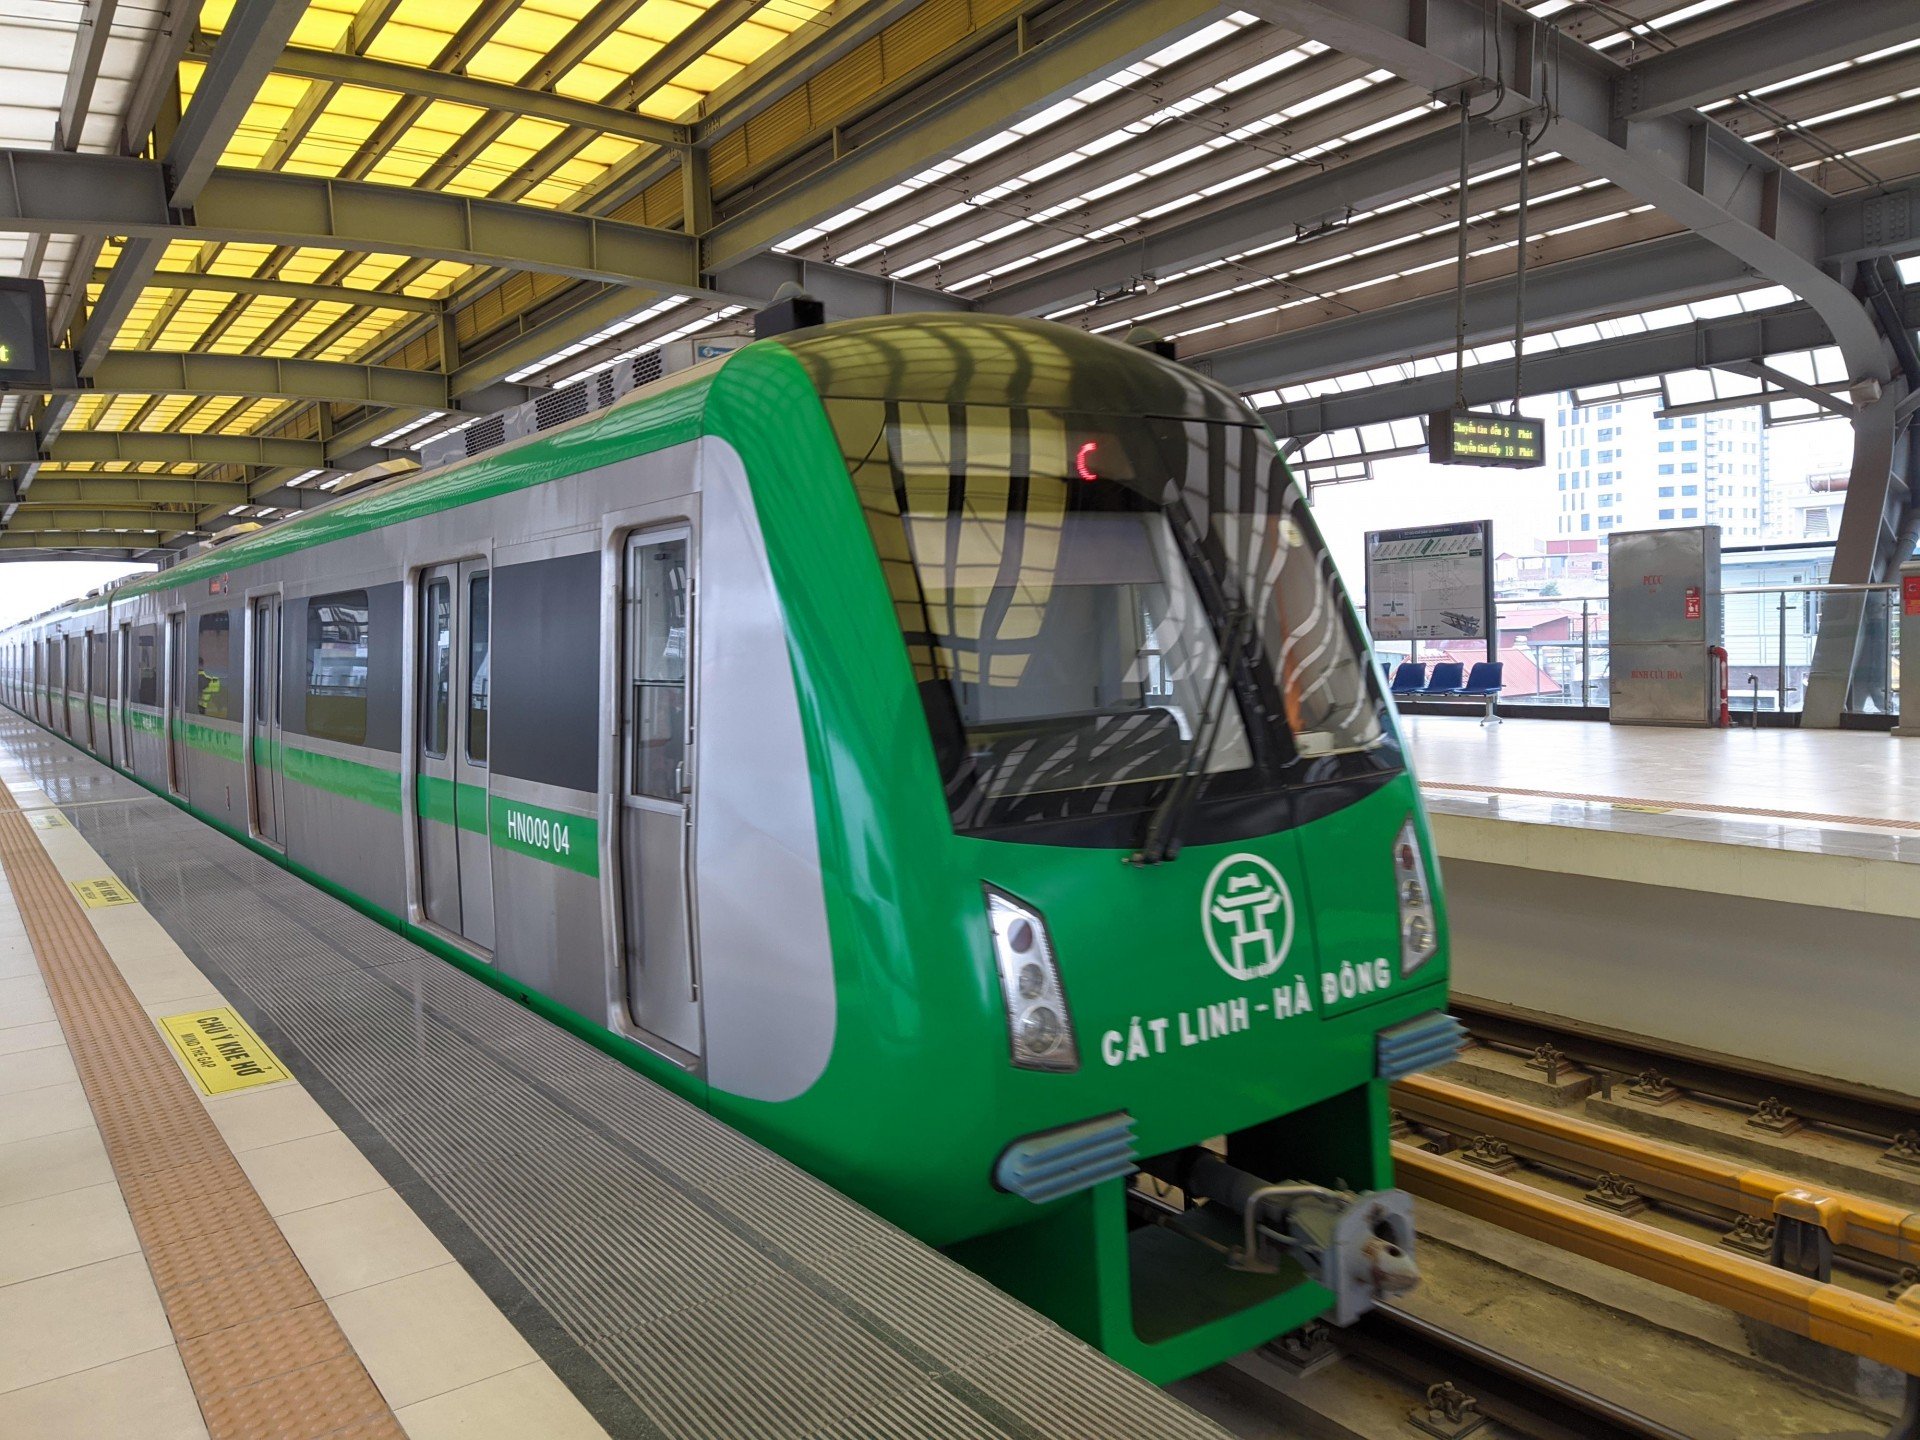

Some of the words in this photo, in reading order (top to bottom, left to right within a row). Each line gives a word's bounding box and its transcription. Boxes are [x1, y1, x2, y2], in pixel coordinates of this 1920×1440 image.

[1504, 427, 1510, 438] 8
[1517, 429, 1533, 440] Phút
[1504, 446, 1514, 457] 18
[1518, 448, 1534, 457] Phút
[507, 810, 550, 849] HN009
[552, 822, 570, 855] 04
[196, 1016, 233, 1035] CHÚ
[1101, 1016, 1169, 1067] CÁT
[1178, 997, 1249, 1046] LINH
[1272, 974, 1313, 1020] HÀ
[190, 1045, 208, 1058] THE
[215, 1041, 250, 1062] KHE
[197, 1056, 217, 1069] GAP
[230, 1060, 273, 1077] HỞ
